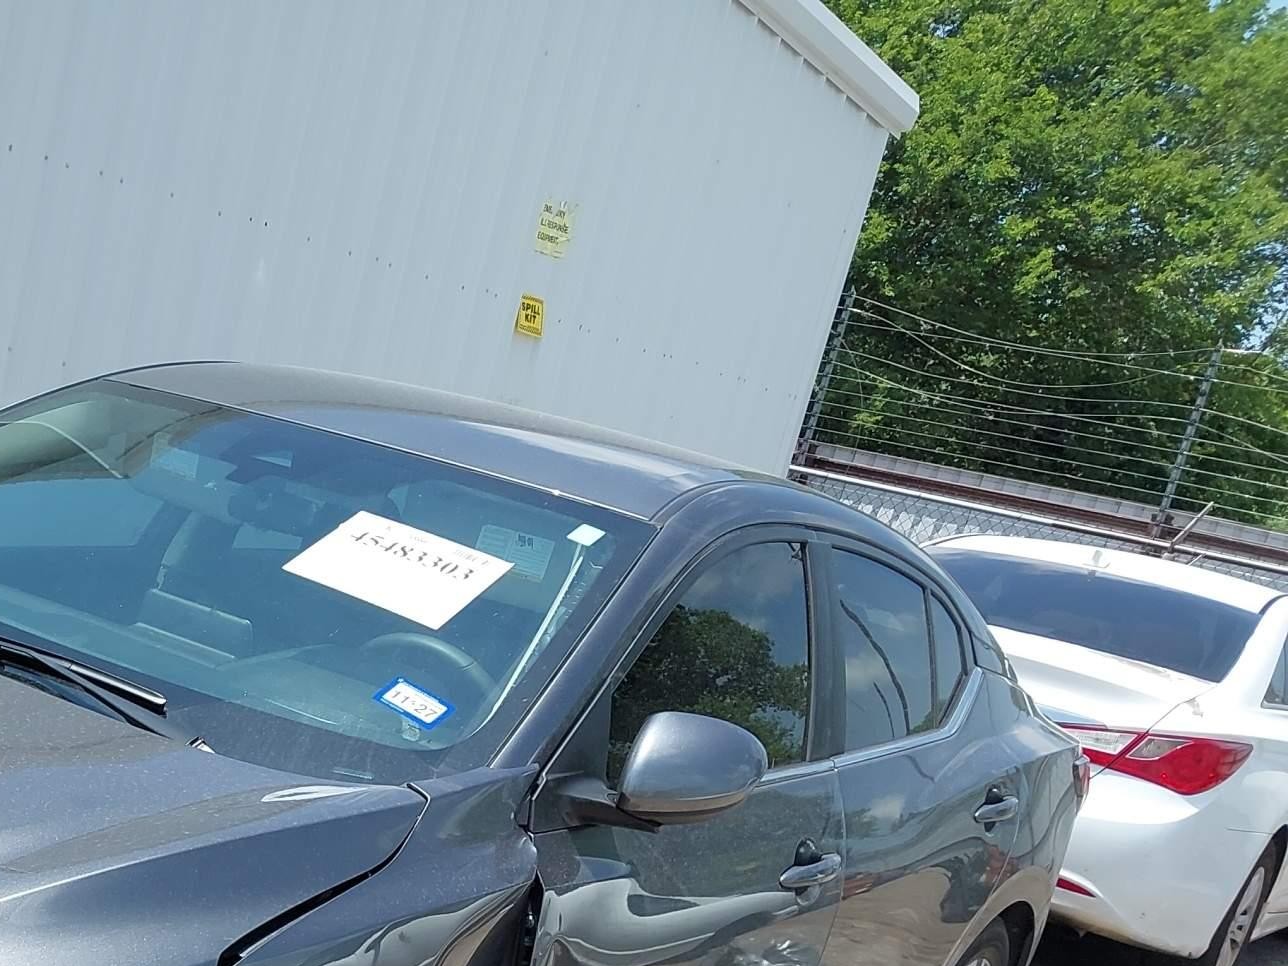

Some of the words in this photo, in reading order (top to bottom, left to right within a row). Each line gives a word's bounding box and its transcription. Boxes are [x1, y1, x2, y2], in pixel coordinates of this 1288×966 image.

[522, 302, 540, 315] SPILL
[525, 313, 536, 324] KIT
[351, 531, 473, 580] 45483303
